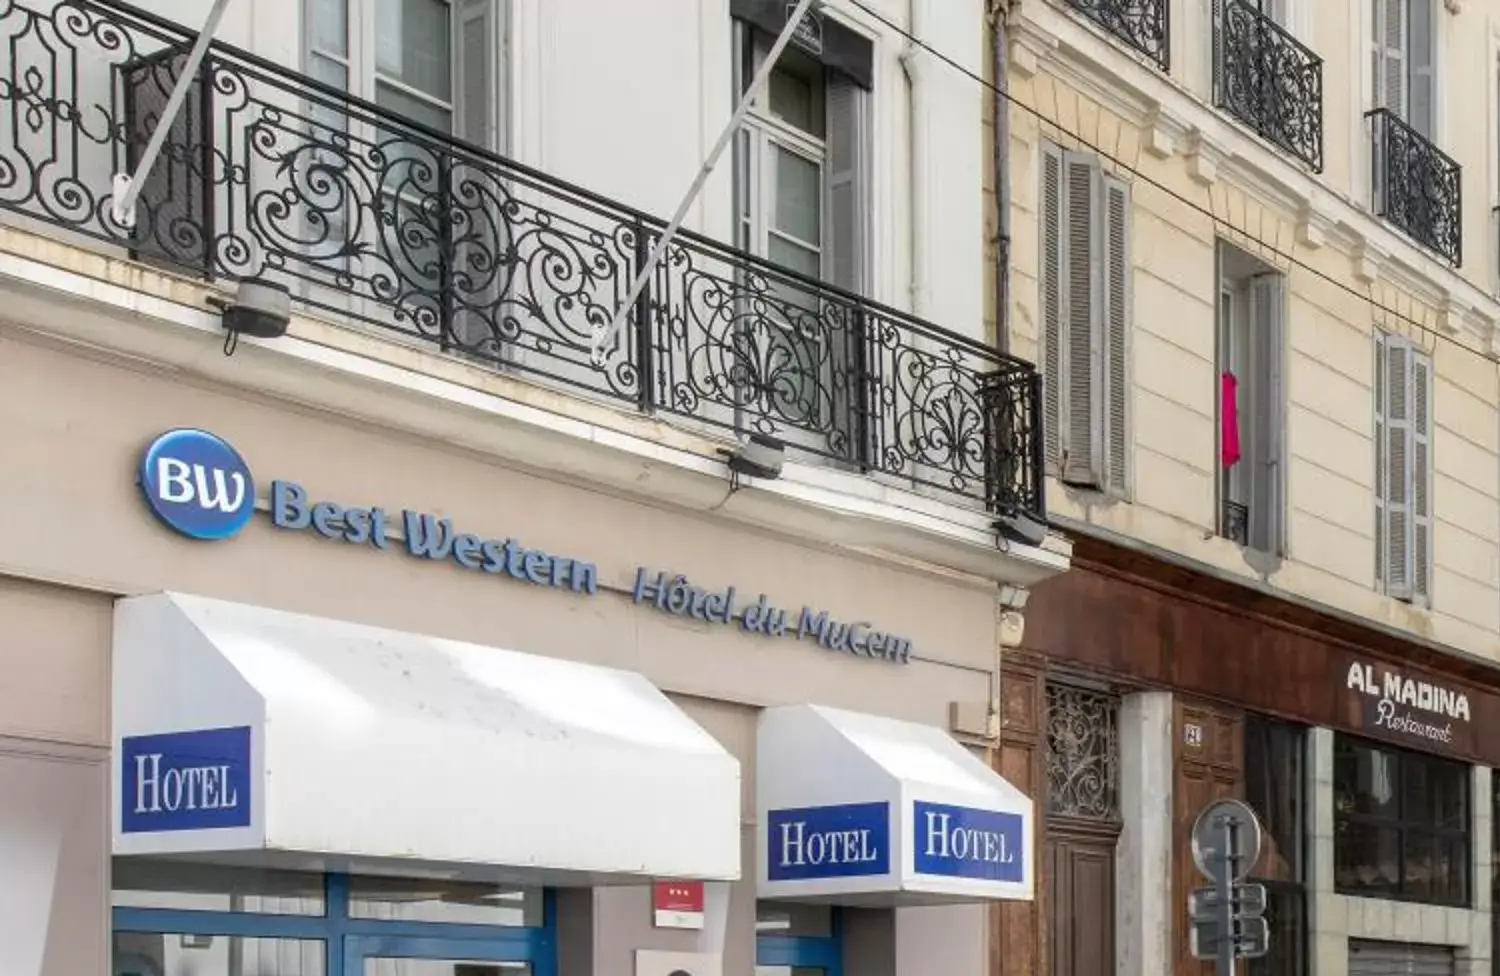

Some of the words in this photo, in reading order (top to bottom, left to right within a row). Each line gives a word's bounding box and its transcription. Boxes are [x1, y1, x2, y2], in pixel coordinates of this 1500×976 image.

[157, 456, 246, 513] BW
[271, 479, 391, 549] Best
[402, 509, 598, 594] Western
[632, 566, 735, 624] Hôtel
[741, 593, 789, 637] du
[796, 605, 912, 664] MuCem
[1347, 661, 1379, 696] AL
[1384, 671, 1470, 722] MADINA
[1375, 698, 1452, 743] Restaurant
[133, 753, 239, 813] HOTEL
[779, 821, 877, 867] HOTEL
[924, 810, 1014, 864] HOTEL
